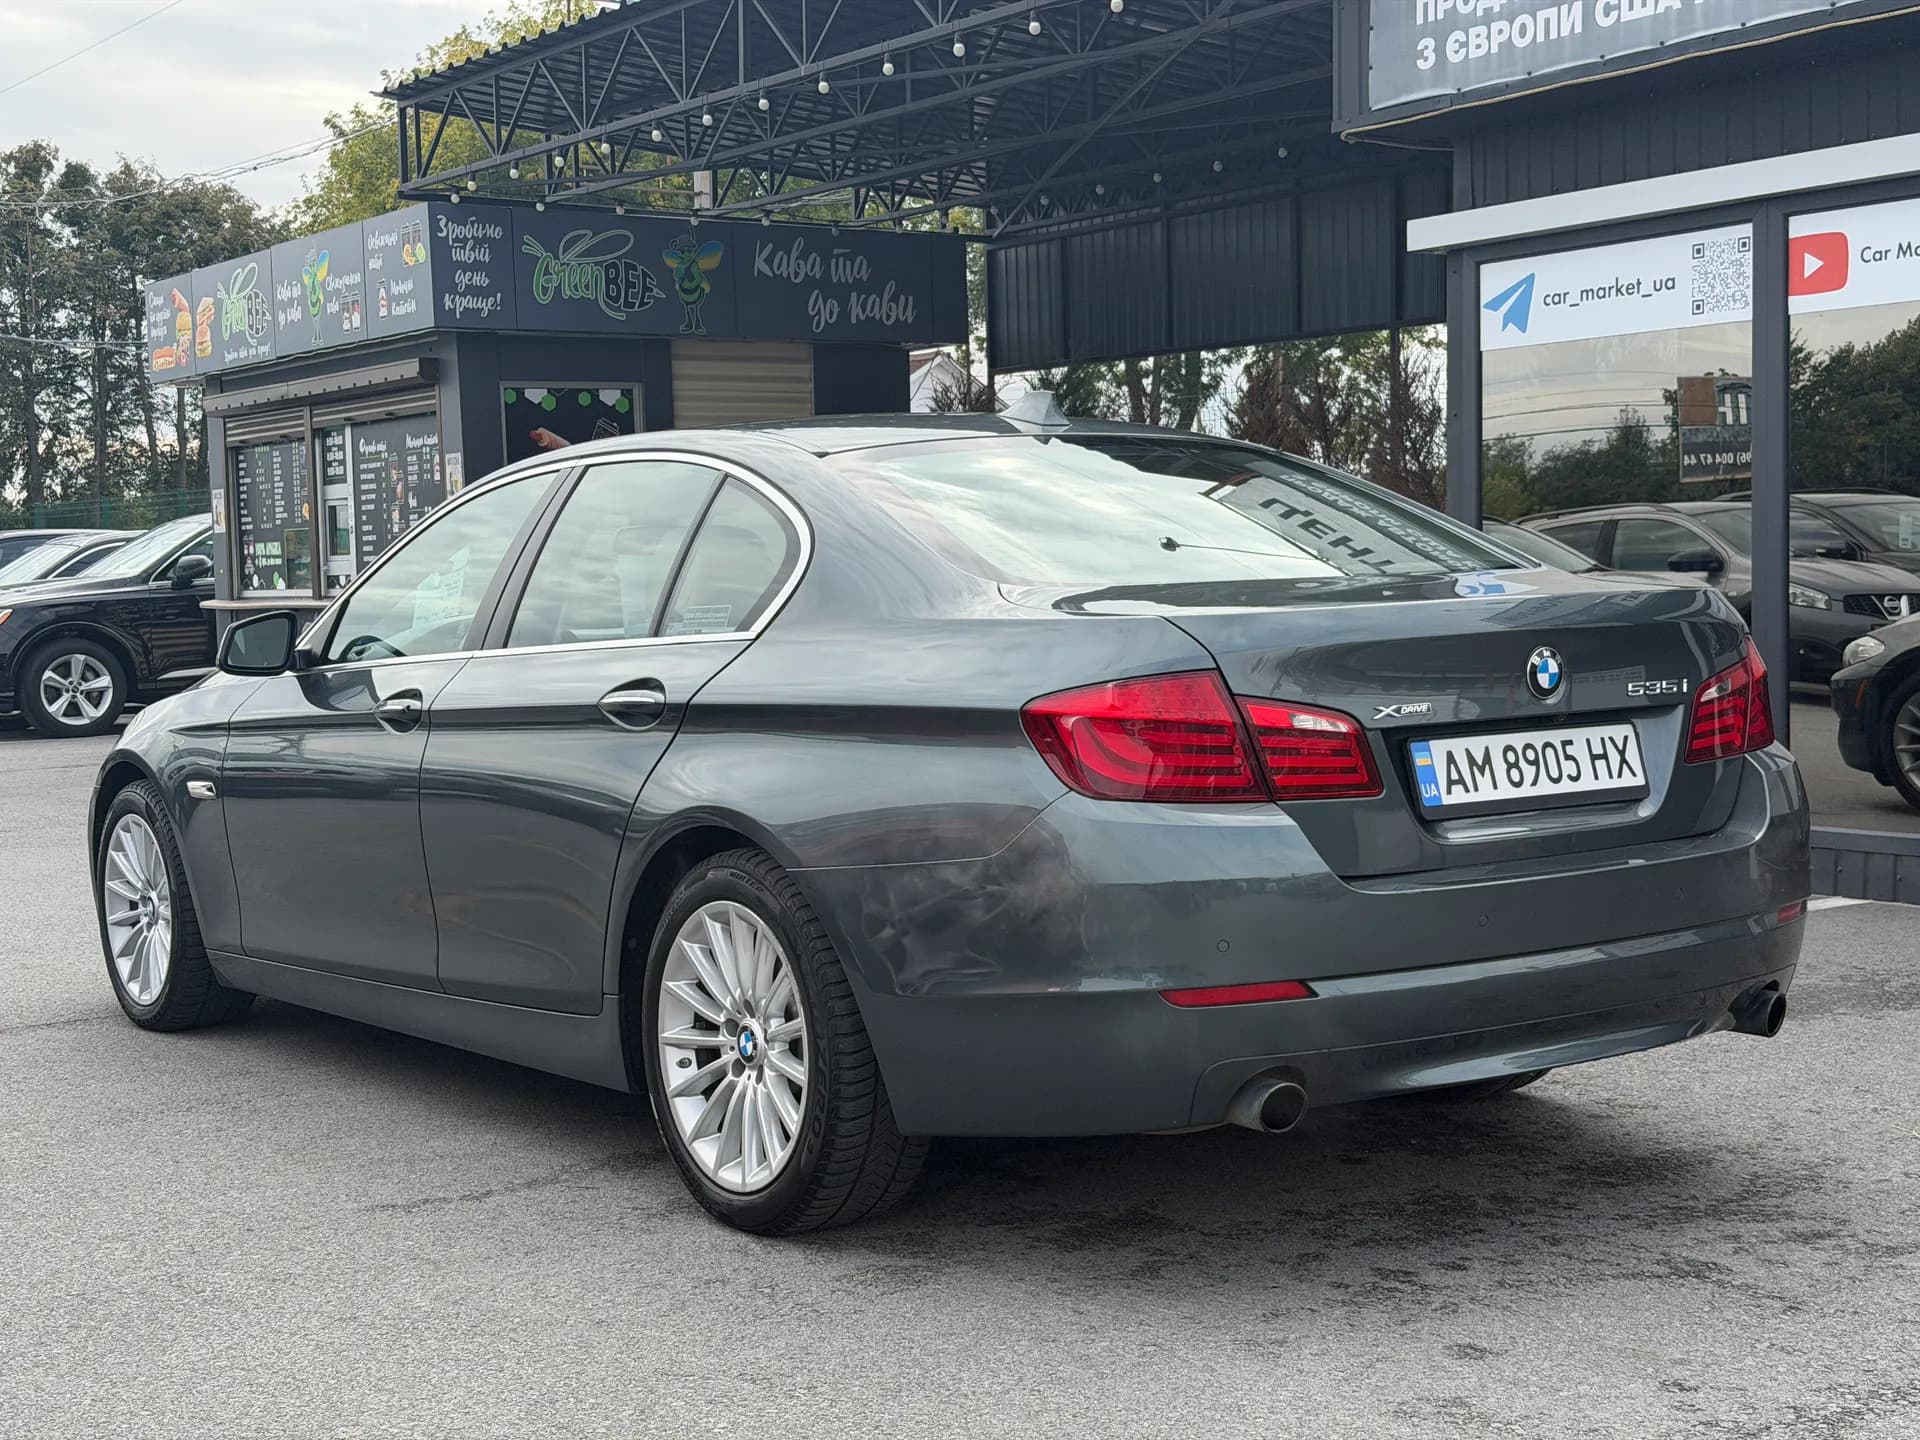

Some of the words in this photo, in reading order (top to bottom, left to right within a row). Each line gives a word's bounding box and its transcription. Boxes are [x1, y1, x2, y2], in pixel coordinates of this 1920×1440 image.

[1416, 37, 1436, 70] З
[1446, 0, 1582, 63] ЄВРОПИ
[437, 214, 504, 246] Зробимо
[452, 239, 491, 264] твій
[754, 236, 825, 284] Кава
[830, 248, 872, 284] та
[1860, 246, 1891, 264] Car
[455, 269, 490, 293] день
[1542, 276, 1677, 308] car_market_ua
[443, 292, 502, 319] краще!
[807, 289, 841, 333] до
[848, 280, 917, 326] кави
[1626, 678, 1688, 697] 535i
[1445, 746, 1499, 796] AM
[1502, 739, 1582, 788] 8905
[1585, 735, 1637, 781] HX
[1421, 783, 1440, 798] UA
